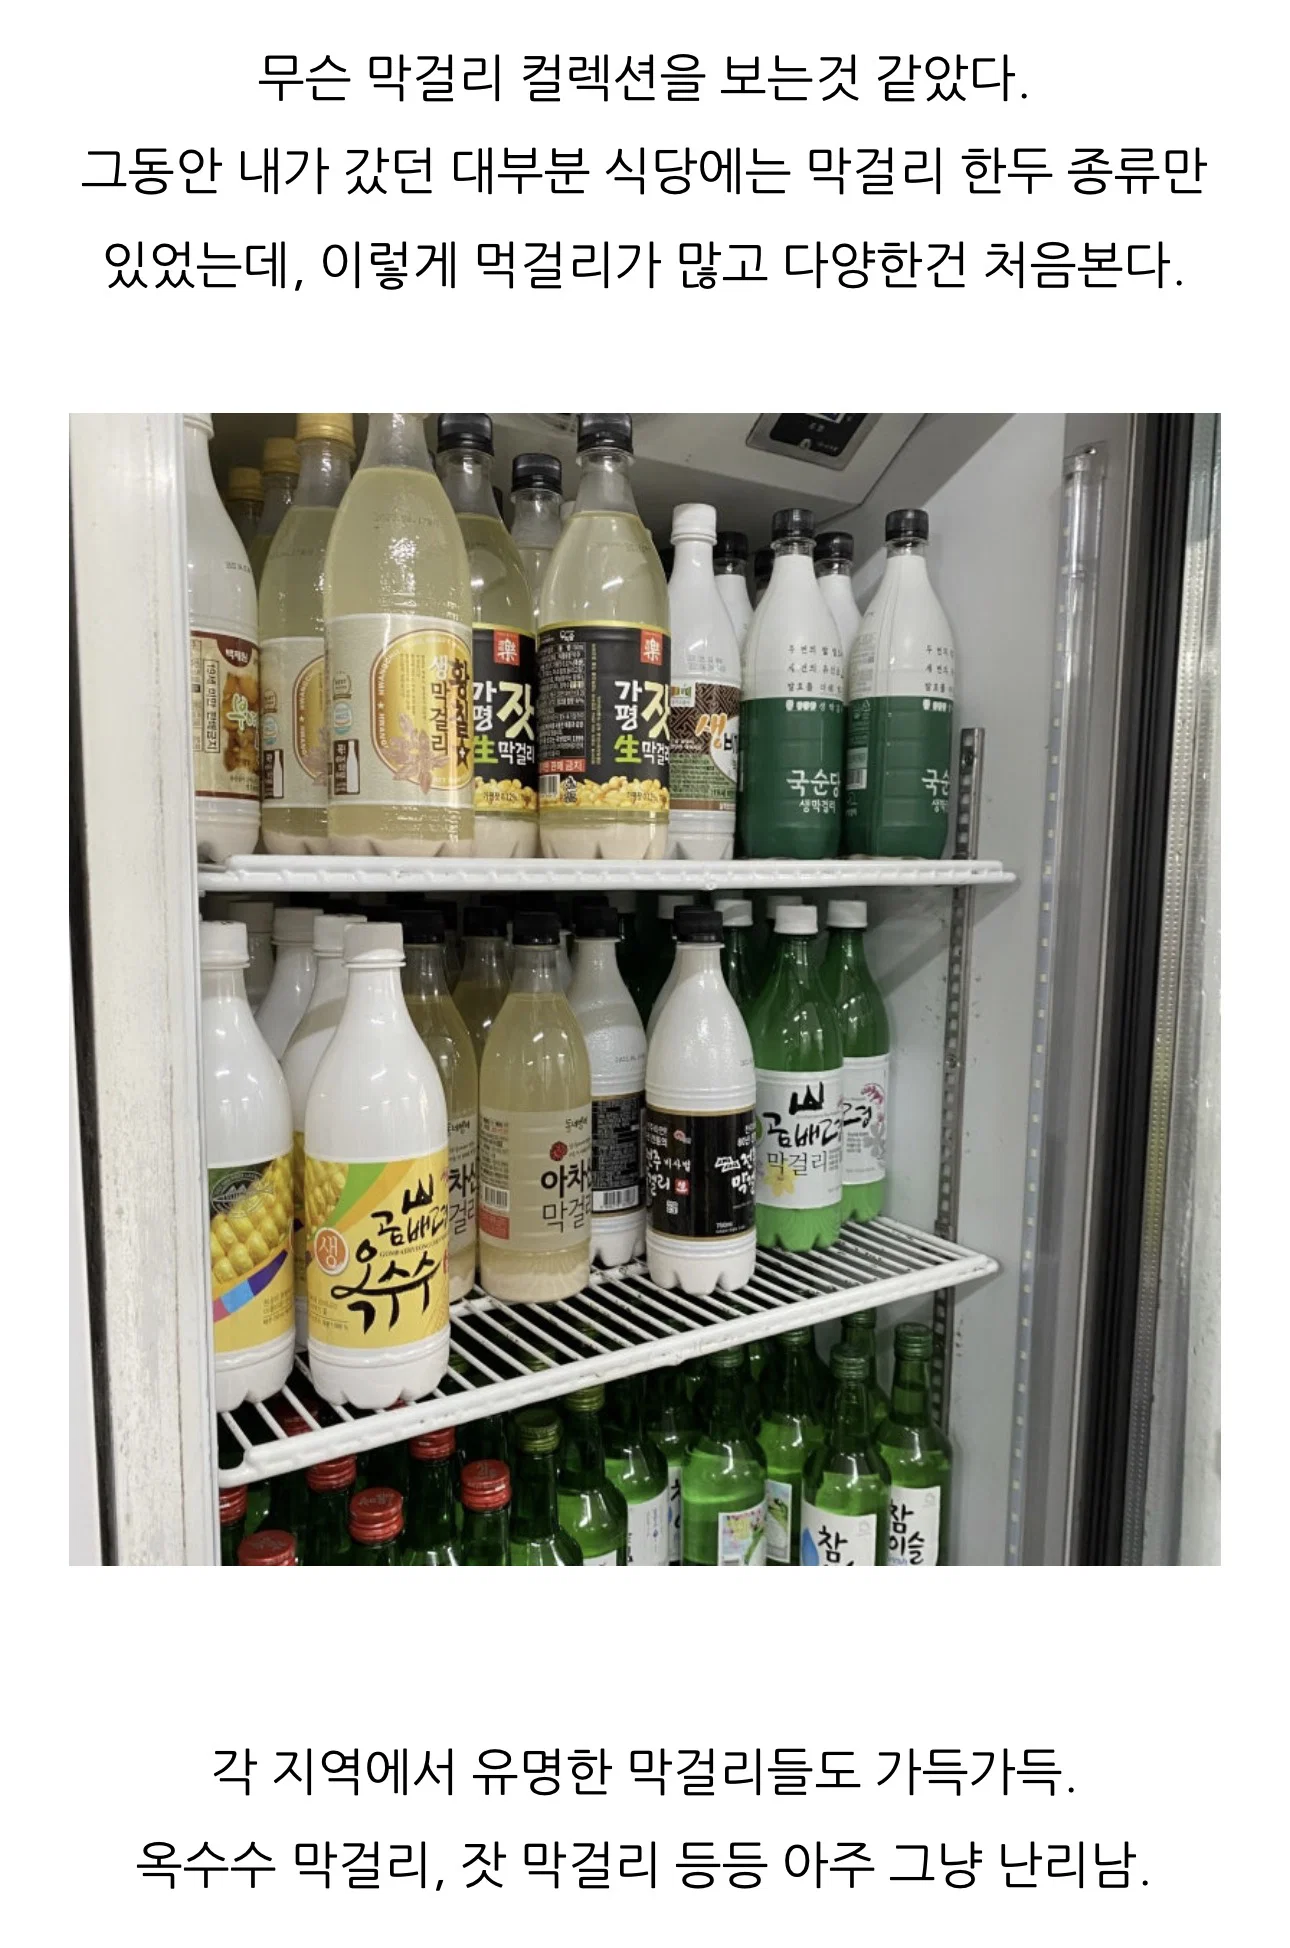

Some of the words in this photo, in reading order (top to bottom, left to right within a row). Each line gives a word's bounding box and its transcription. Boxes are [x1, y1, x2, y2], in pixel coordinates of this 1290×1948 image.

[473, 680, 497, 732] 가평
[496, 680, 535, 741] 잣
[614, 680, 643, 731] 가평
[498, 740, 535, 766] 막걸리
[613, 734, 642, 764] 生
[767, 1151, 827, 1176] 막걸리
[320, 1236, 338, 1269] 생
[331, 1238, 441, 1335] 옥수수
[818, 1525, 848, 1563] 참
[889, 1530, 925, 1565] 이슬
